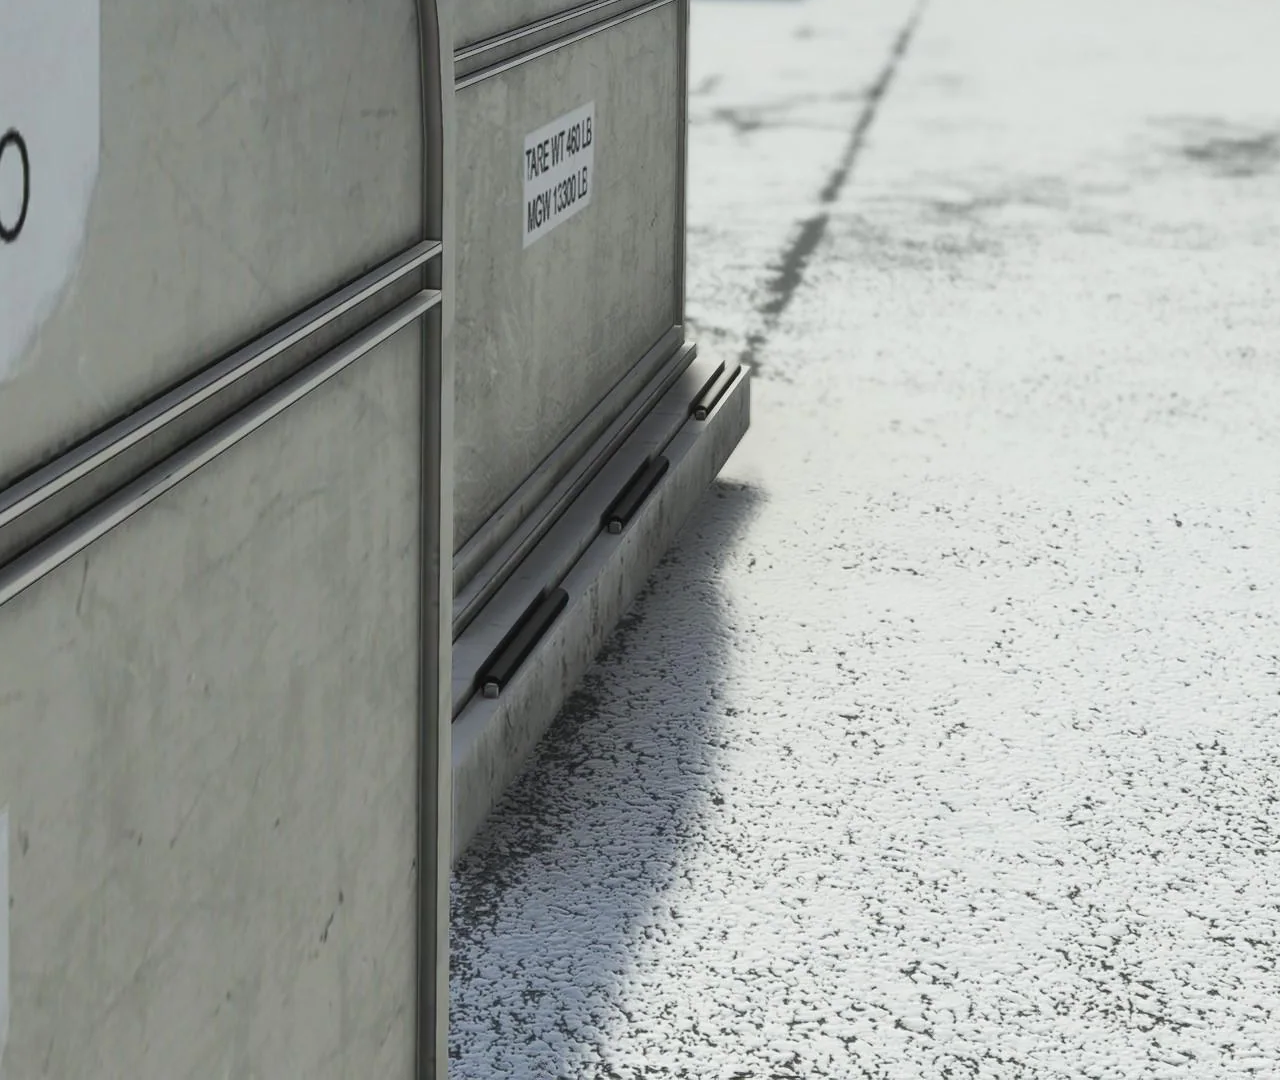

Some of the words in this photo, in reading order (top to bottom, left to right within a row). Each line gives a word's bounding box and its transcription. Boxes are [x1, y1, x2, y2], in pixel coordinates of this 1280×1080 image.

[525, 139, 550, 182] TARE
[551, 130, 565, 168] WT
[566, 123, 580, 158] 460
[582, 117, 592, 150] LB
[527, 188, 551, 234] MGW
[553, 174, 576, 215] 13300
[578, 166, 588, 200] LB
